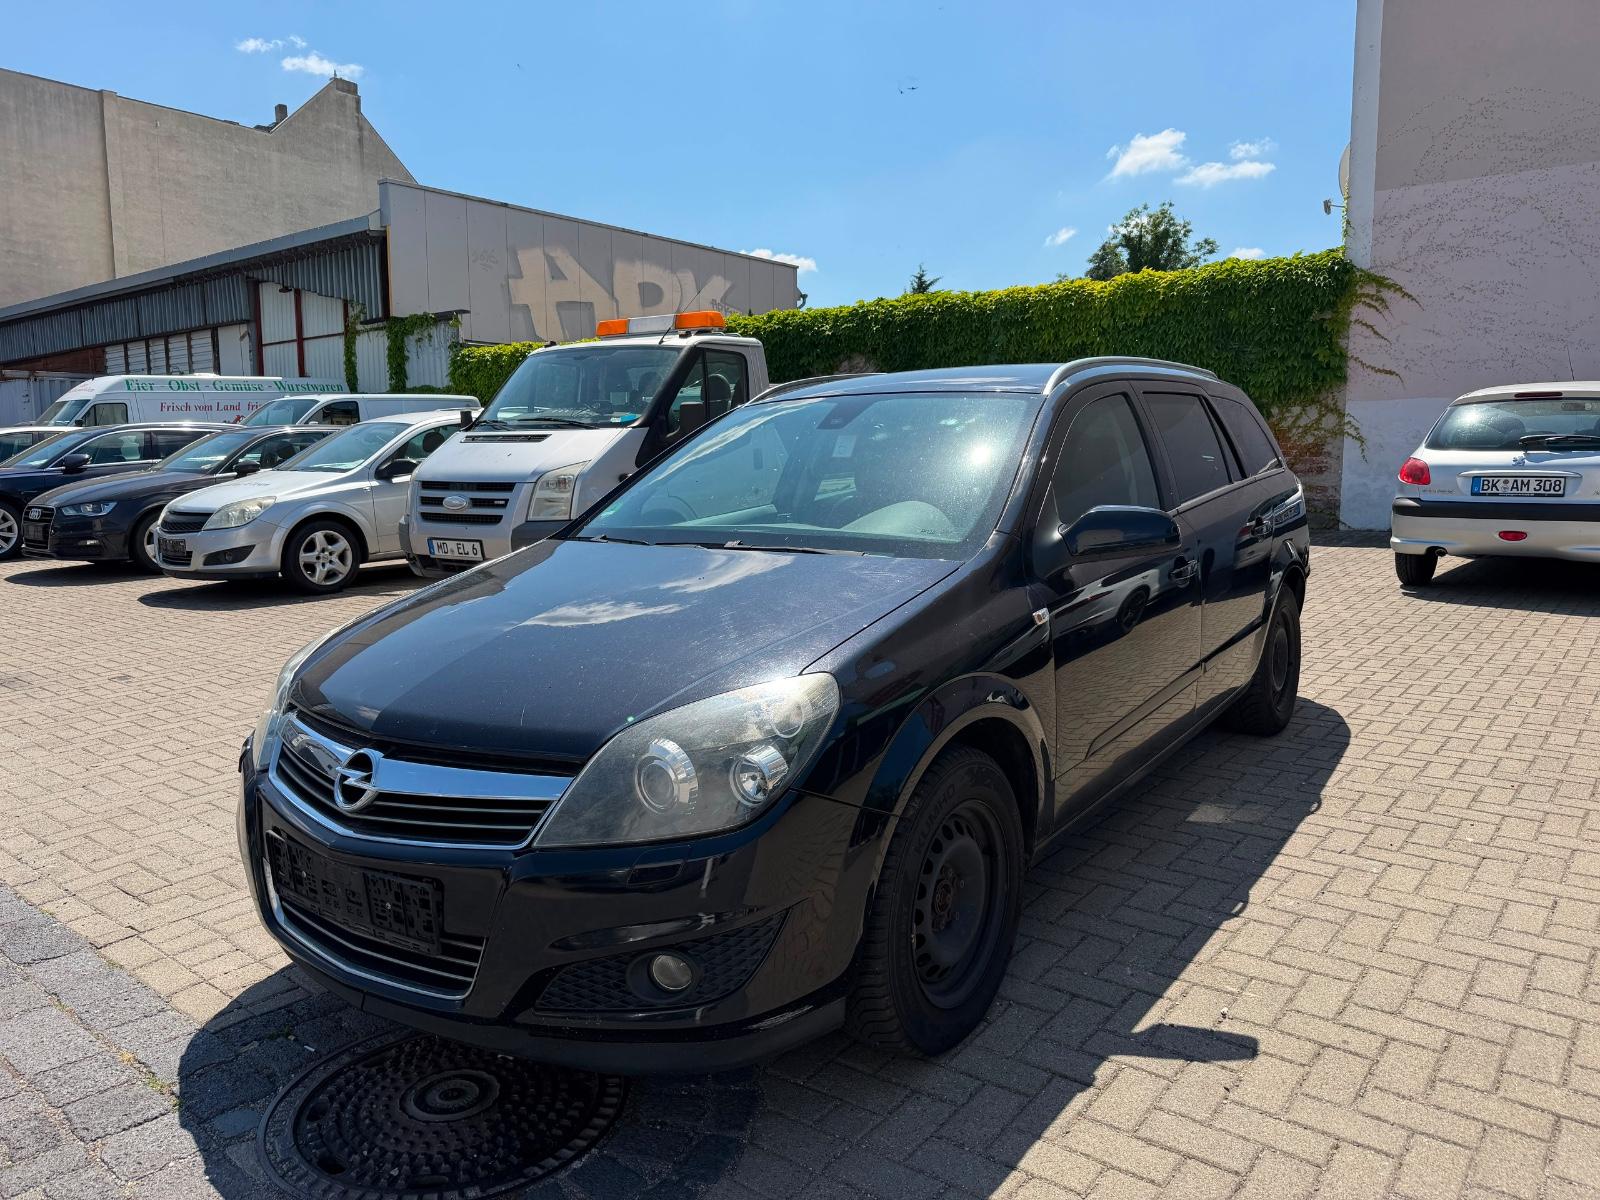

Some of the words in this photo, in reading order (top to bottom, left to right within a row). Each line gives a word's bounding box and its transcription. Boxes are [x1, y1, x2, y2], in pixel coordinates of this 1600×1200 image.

[125, 379, 155, 391] Eier
[168, 379, 201, 392] Obst
[212, 380, 264, 392] Gemüse
[273, 381, 344, 392] Wurstwaren
[160, 402, 191, 412] Frisch
[216, 402, 241, 412] Land
[1481, 479, 1501, 492] BK
[1510, 479, 1531, 492] AM
[1533, 479, 1562, 492] 308
[437, 542, 449, 554] MD
[456, 542, 469, 555] EL
[472, 543, 478, 556] 6
